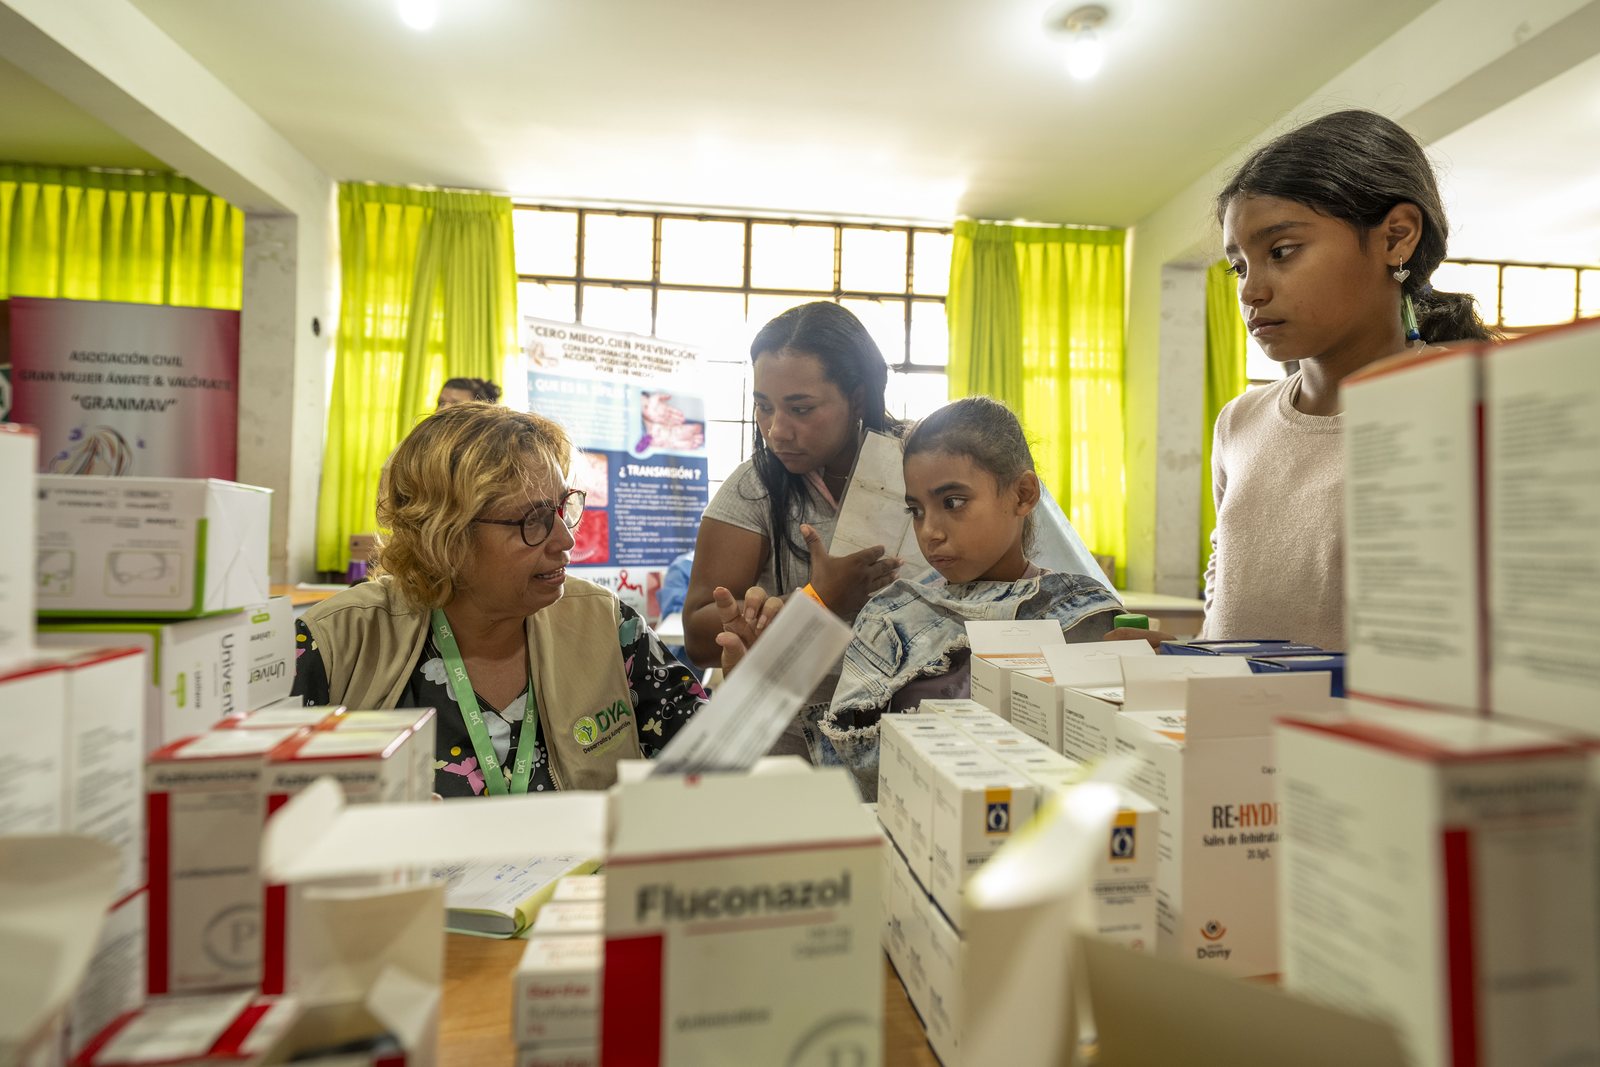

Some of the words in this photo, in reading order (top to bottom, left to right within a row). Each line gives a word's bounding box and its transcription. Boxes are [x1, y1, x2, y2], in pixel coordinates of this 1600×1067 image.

[69, 350, 150, 367] ASOCIACIÓN
[152, 352, 184, 367] CIVIL
[19, 368, 56, 382] GRAN
[59, 370, 104, 385] MUJER
[154, 374, 164, 386] &
[167, 374, 233, 392] VALÓRATE
[627, 463, 695, 481] TRANSMISIÓN
[439, 625, 453, 640] DYA
[453, 667, 468, 683] DYA
[469, 710, 484, 726] DYA
[595, 699, 631, 733] DYA
[485, 755, 500, 771] DYA
[1203, 834, 1226, 847] Sales
[1228, 834, 1238, 846] de
[635, 869, 854, 925] Fluconazol
[1196, 947, 1232, 960] Dony
